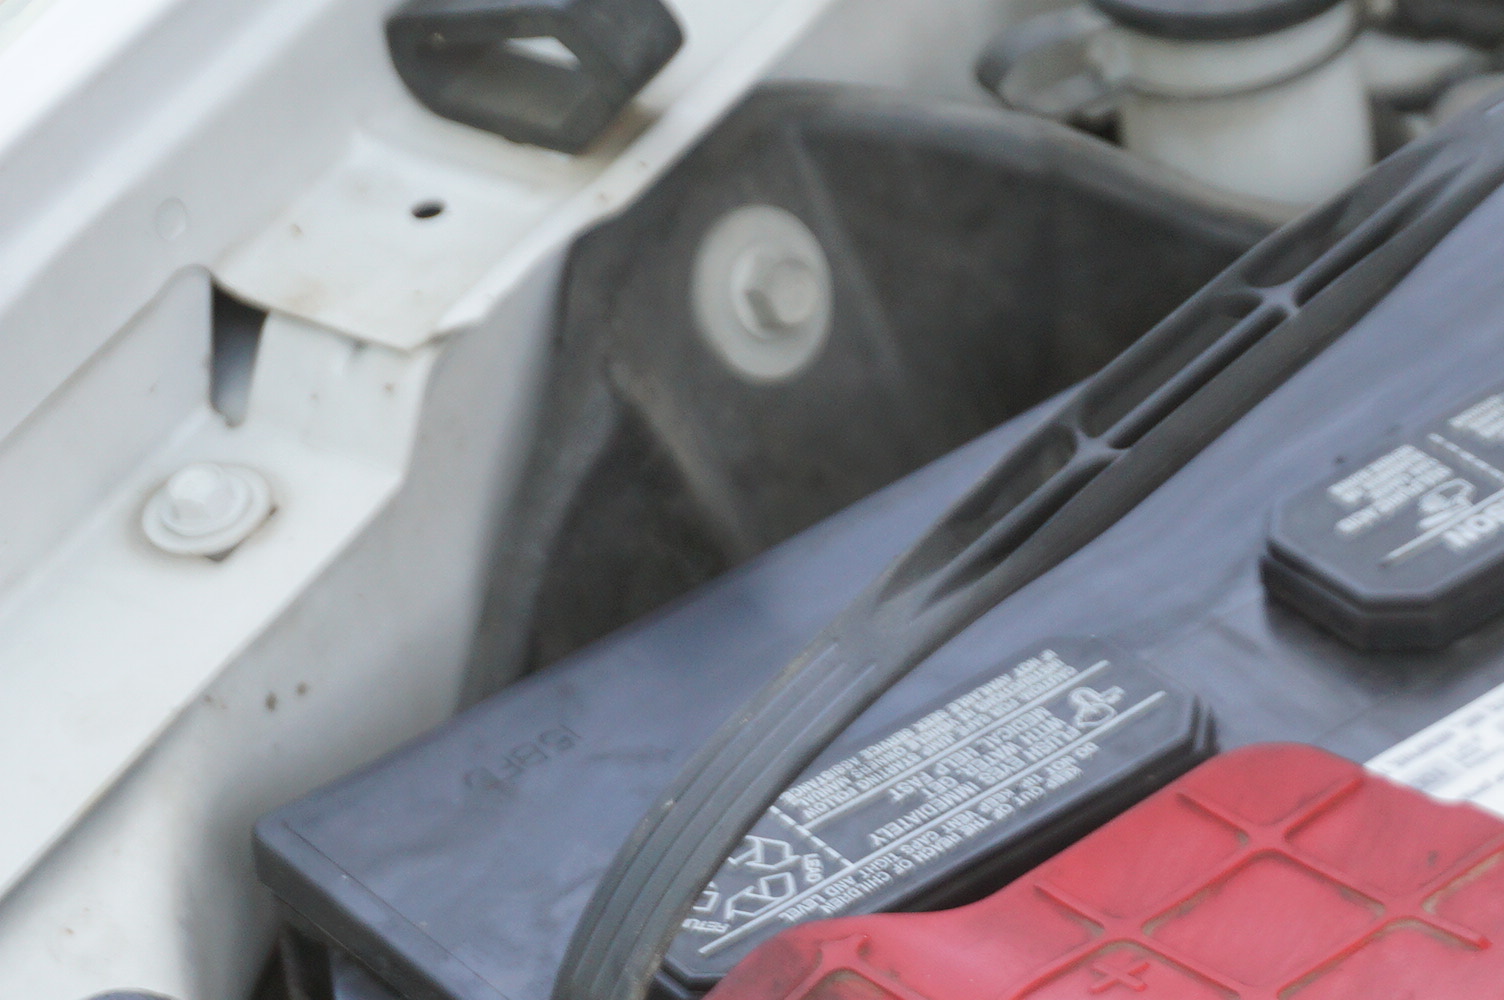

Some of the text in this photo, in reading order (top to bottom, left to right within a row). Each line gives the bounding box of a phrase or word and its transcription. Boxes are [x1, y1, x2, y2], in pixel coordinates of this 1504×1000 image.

[1015, 714, 1068, 746] WITH
[882, 704, 1054, 801] MEDICAL HELP FAST
[1070, 740, 1101, 759] DO
[1041, 754, 1077, 776] NOT
[863, 723, 1084, 847] FLUSH EYES IMMEDIATELY
[915, 773, 960, 800] GET
[799, 784, 860, 820] FOLLOW
[973, 787, 1018, 813] KEEP
[936, 808, 981, 834] VENT
[817, 764, 1084, 914] KEEP OUT OF THE REACH OF CHILDREN
[897, 828, 943, 856] CAPS
[802, 854, 822, 883] LEAD
[853, 850, 903, 879] TIGHT
[821, 874, 860, 897] AND
